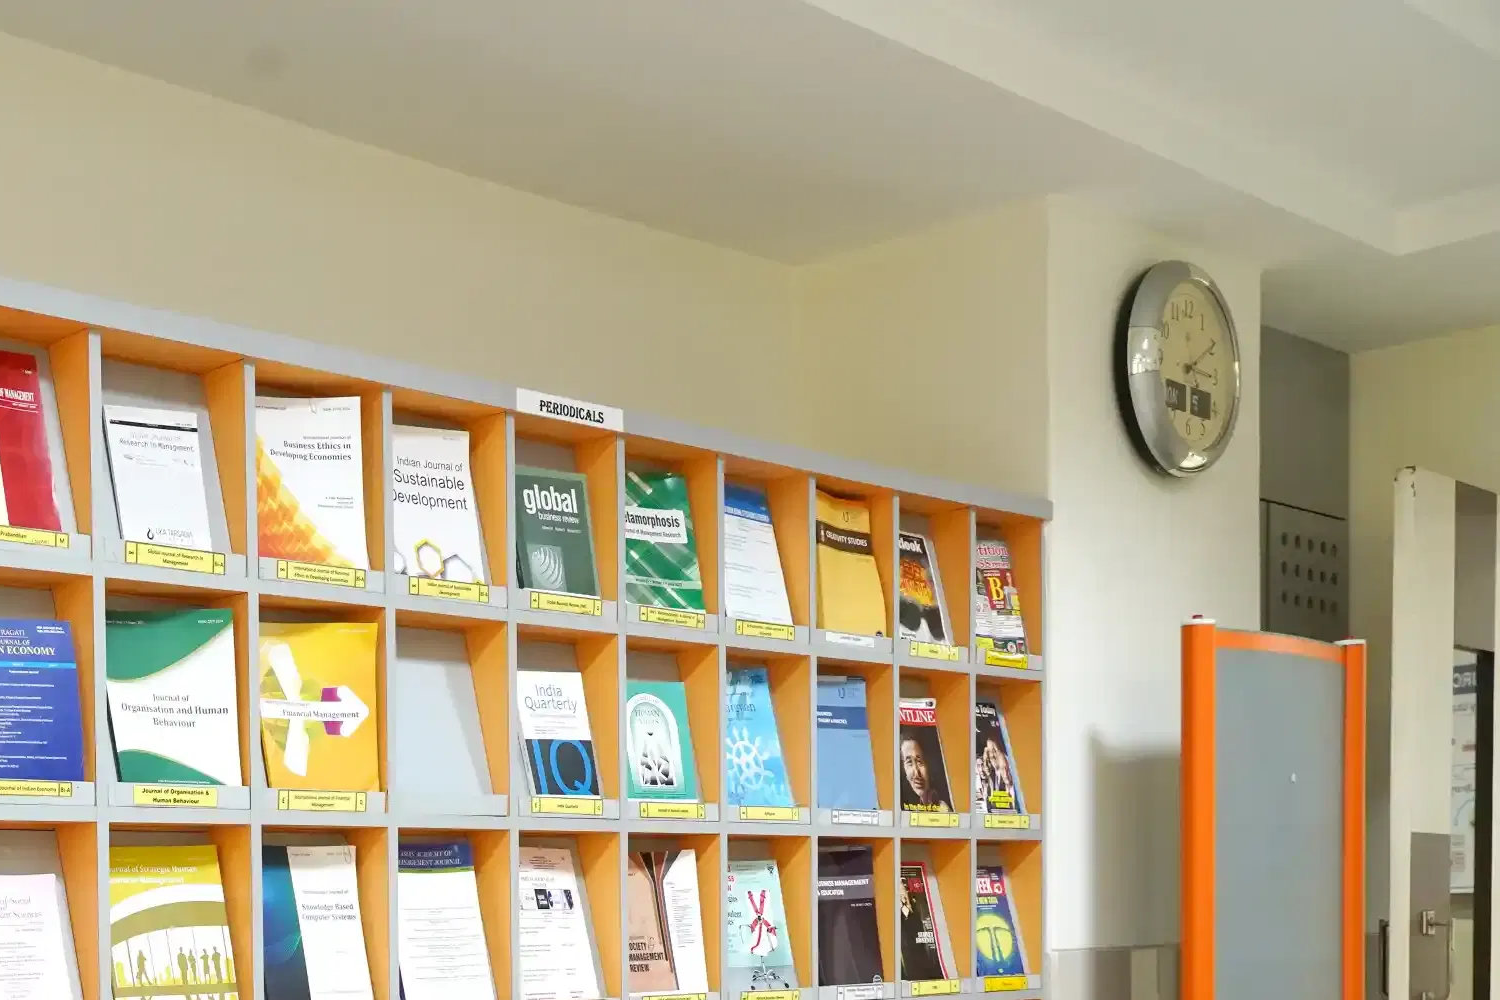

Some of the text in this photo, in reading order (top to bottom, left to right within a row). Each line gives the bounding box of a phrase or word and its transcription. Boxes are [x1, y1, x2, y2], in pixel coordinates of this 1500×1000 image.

[1171, 302, 1179, 320] 11
[1184, 300, 1194, 319] 12
[540, 400, 604, 424] PERIODICALS
[1186, 418, 1191, 435] 6
[284, 441, 315, 450] Business
[270, 450, 308, 461] Developing
[397, 456, 462, 472] Indian Journal of
[523, 484, 578, 514] global
[826, 530, 867, 548] CREATIVITY STUDIES
[7, 646, 56, 656] ECONOMY
[535, 684, 562, 698] India
[121, 703, 228, 715] Organisation and Human
[524, 696, 578, 714] Quarterly
[282, 710, 360, 719] Financial Management
[153, 718, 196, 728] Behaviour
[302, 903, 332, 912] Knowledge
[629, 952, 664, 961] MANAGEMENT
